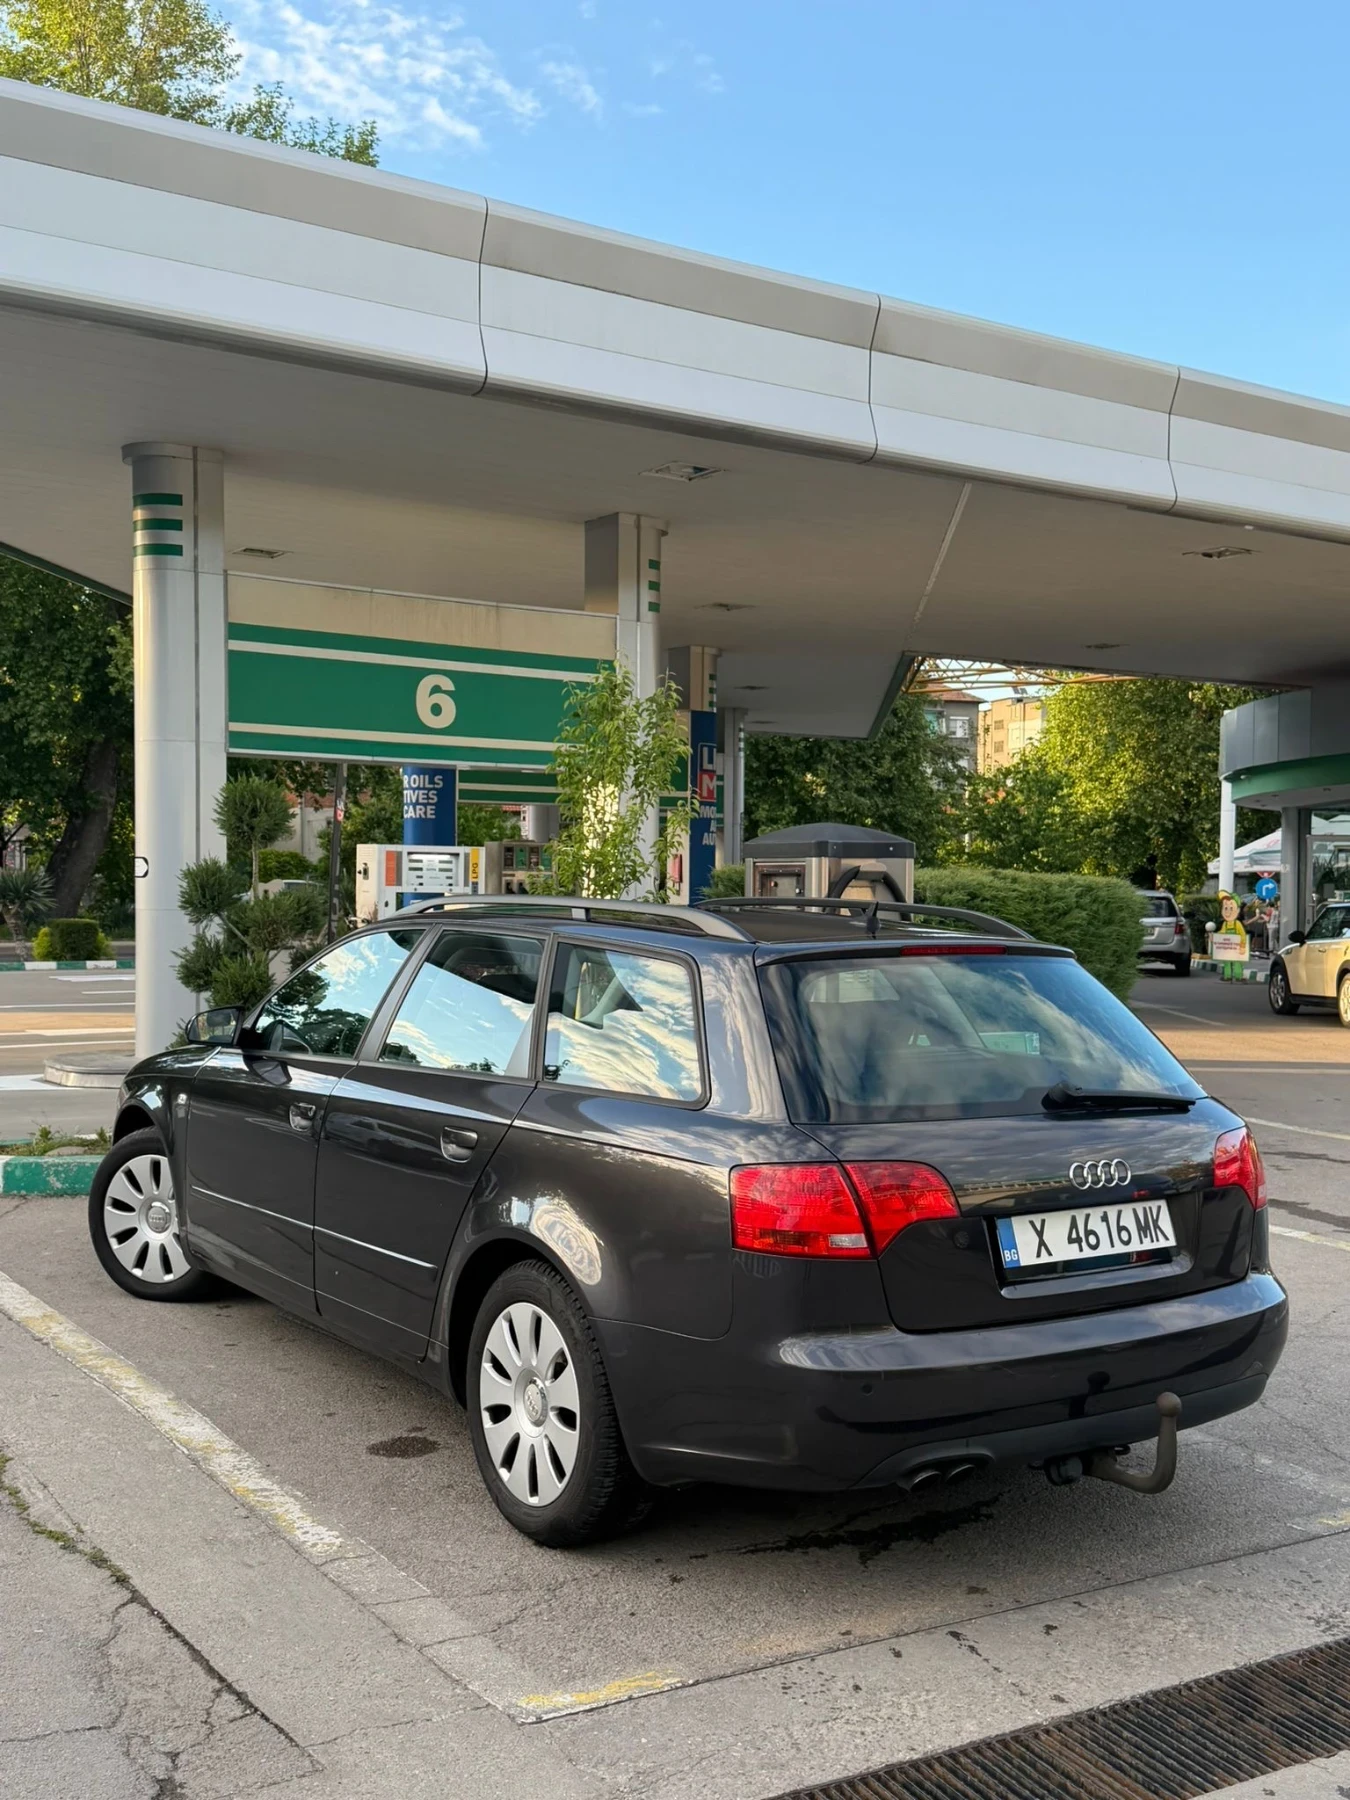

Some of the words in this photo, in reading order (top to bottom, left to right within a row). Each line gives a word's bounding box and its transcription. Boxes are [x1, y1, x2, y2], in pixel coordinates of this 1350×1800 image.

[416, 674, 457, 729] 6
[410, 774, 444, 789] OILS
[403, 805, 436, 819] CARE
[471, 862, 479, 880] LPG
[1028, 1218, 1053, 1259] X
[1004, 1249, 1019, 1261] BG
